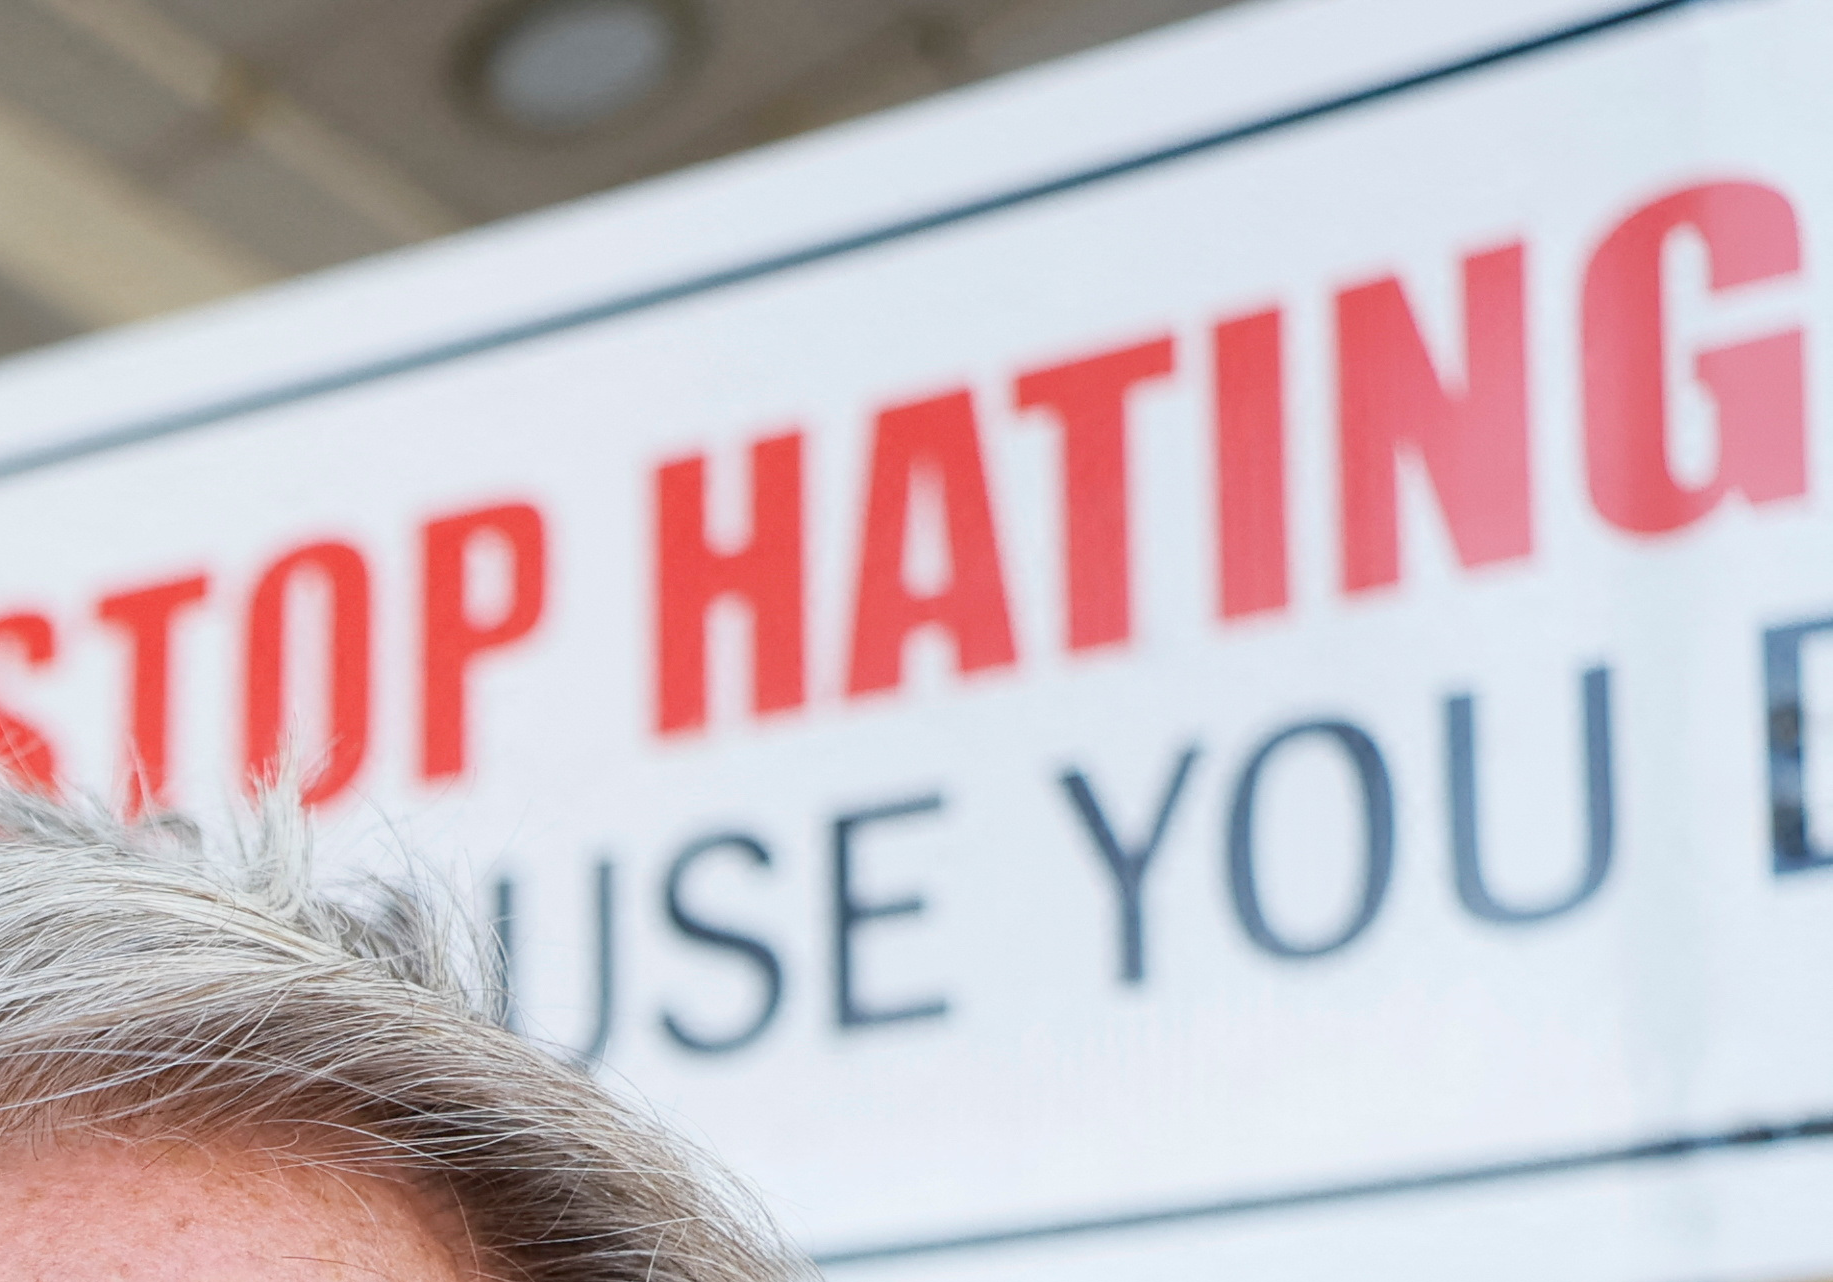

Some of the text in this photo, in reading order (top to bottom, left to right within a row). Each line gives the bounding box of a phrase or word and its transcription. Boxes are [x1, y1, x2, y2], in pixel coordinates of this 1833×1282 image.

[649, 174, 1811, 740] HATING
[493, 790, 948, 1074] USE
[1060, 660, 1620, 988] YOU
